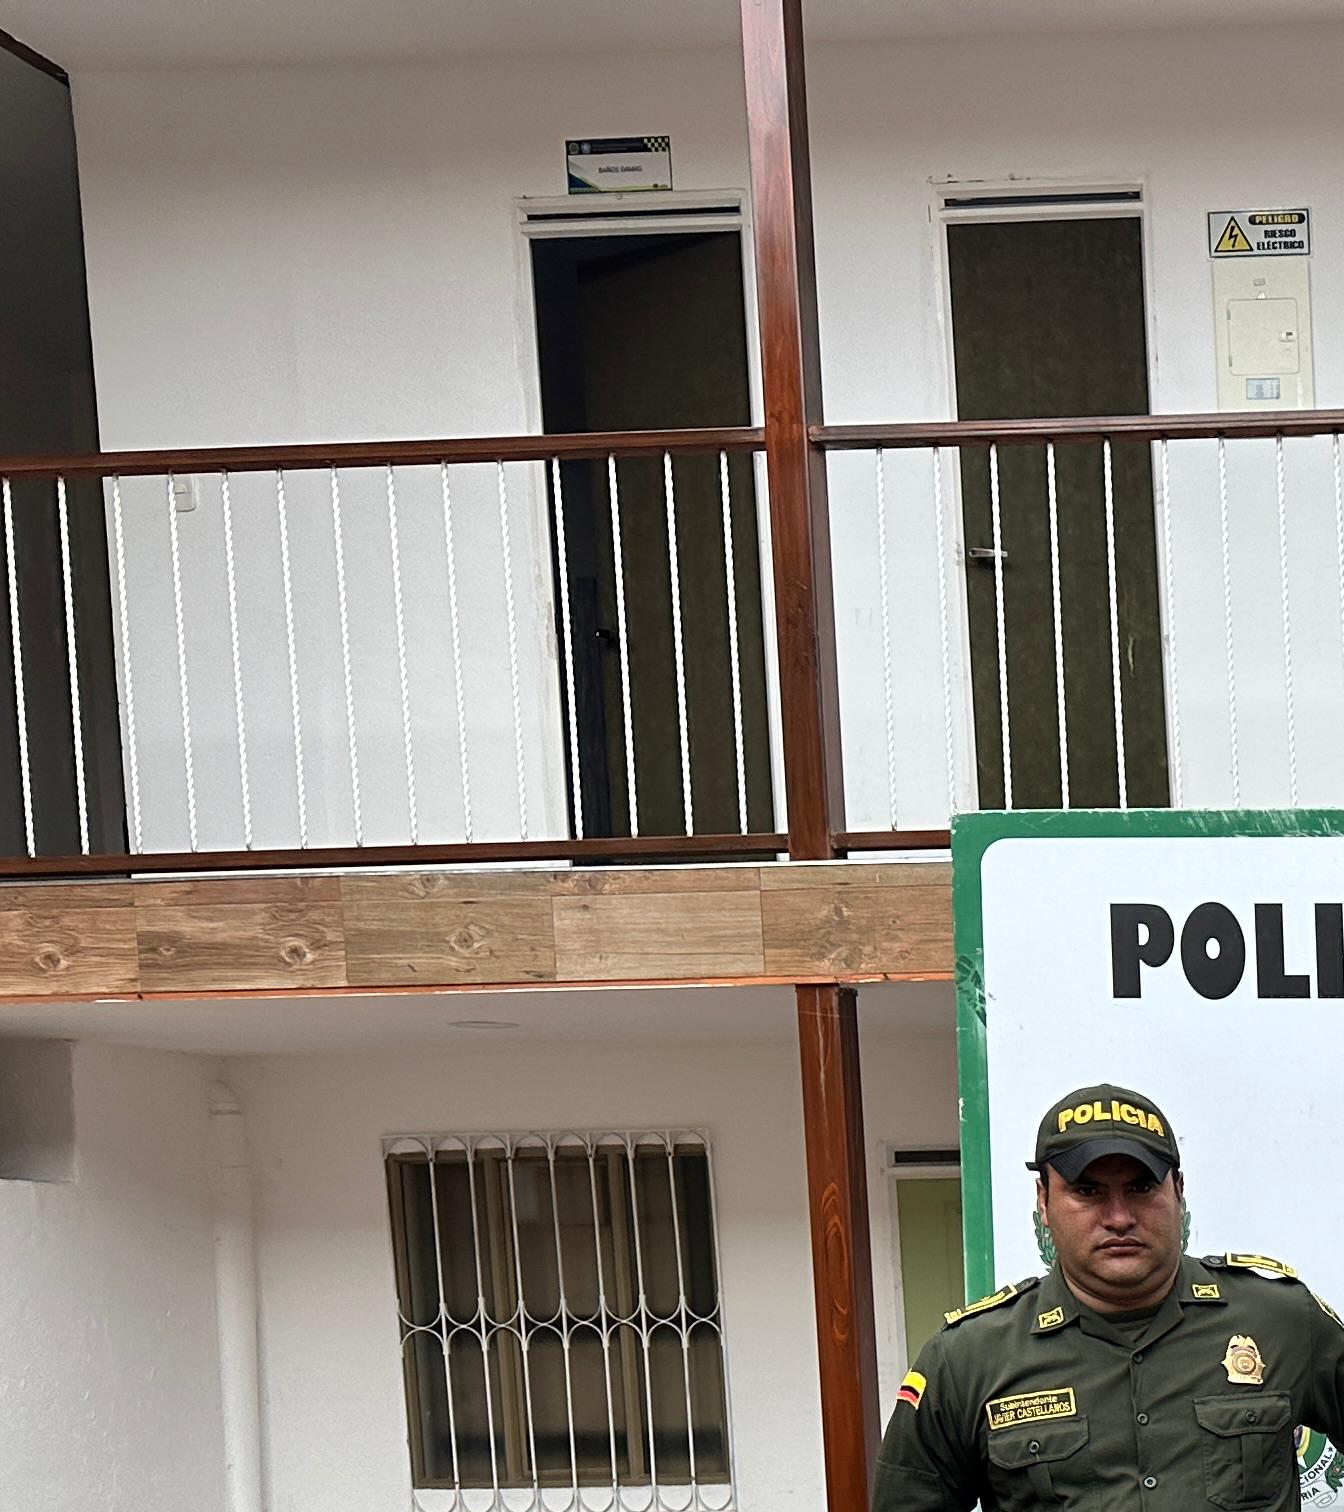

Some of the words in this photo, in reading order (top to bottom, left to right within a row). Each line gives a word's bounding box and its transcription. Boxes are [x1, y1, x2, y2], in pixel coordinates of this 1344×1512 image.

[1255, 214, 1299, 225] PELIGRO
[1264, 228, 1297, 239] RIESGO
[1256, 240, 1305, 251] ELÉCTRICO
[1016, 1401, 1071, 1419] CASTELLANOS
